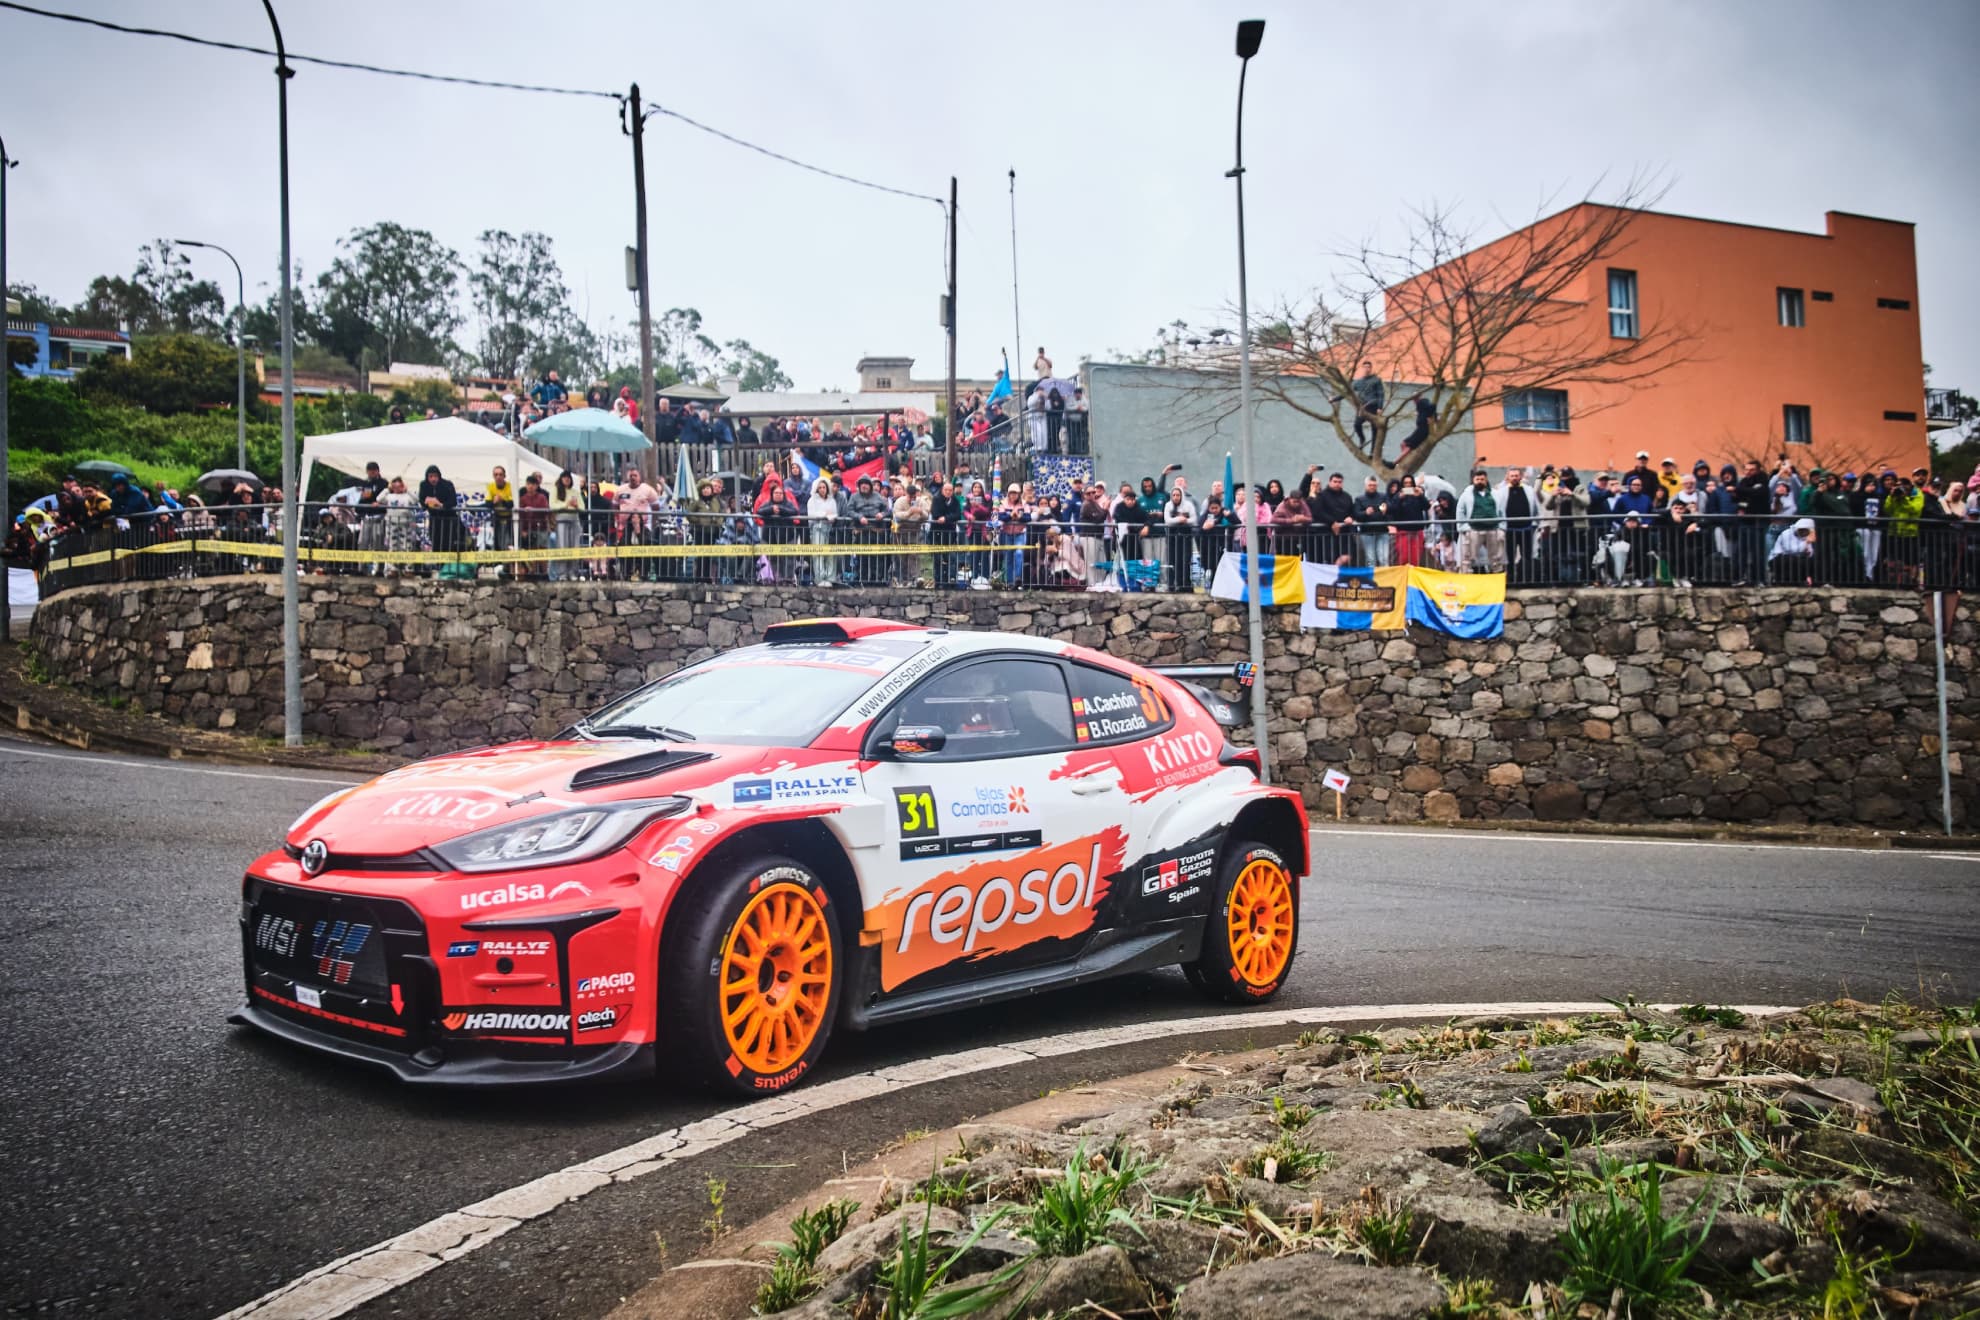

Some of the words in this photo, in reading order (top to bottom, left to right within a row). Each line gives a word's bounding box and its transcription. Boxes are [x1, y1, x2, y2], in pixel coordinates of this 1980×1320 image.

[858, 646, 950, 718] www.msispain.com
[1084, 692, 1138, 716] A.Cachón
[1131, 672, 1170, 723] 31
[1089, 714, 1147, 738] B.Rozada
[776, 777, 856, 790] RALLYE
[777, 790, 811, 798] TEAM
[816, 788, 849, 796] SPAIN
[976, 786, 1005, 800] Islas
[899, 792, 935, 831] 31
[952, 801, 1008, 817] Canarias
[1180, 848, 1215, 866] TOYOTA
[1180, 858, 1212, 875] GAZOO
[1144, 870, 1178, 894] GR
[461, 883, 545, 910] ucalsa
[897, 842, 1100, 954] repsol
[1168, 886, 1200, 903] Spain
[482, 941, 550, 950] RALLYE
[592, 972, 635, 990] PAGID
[577, 986, 636, 999] RACING
